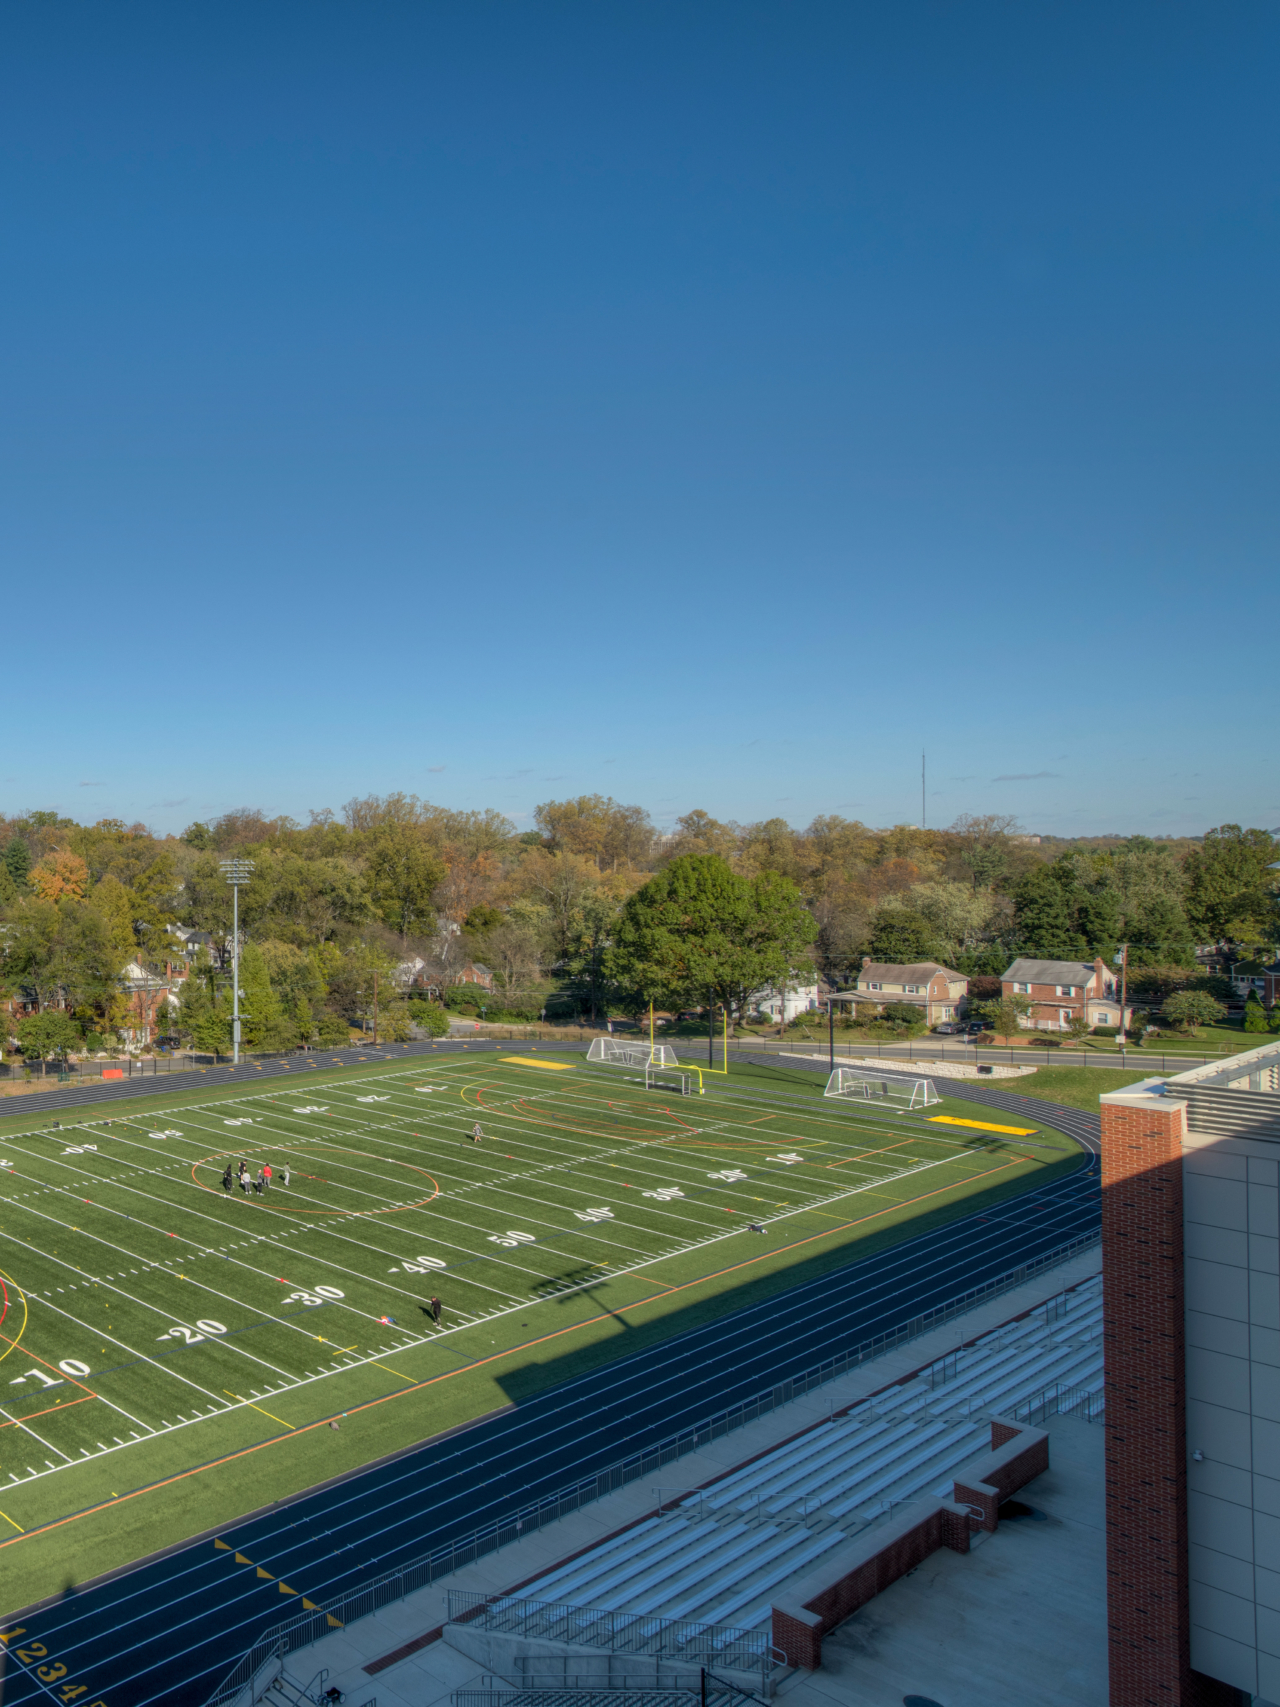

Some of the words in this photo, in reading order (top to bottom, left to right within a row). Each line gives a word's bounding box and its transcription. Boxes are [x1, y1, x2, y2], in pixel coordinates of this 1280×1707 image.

[148, 1129, 184, 1139] 50
[65, 1144, 98, 1154] 40
[765, 1153, 804, 1165] 10
[707, 1169, 748, 1183] 20
[642, 1188, 685, 1201] 30
[573, 1208, 615, 1222] 40
[487, 1230, 536, 1247] 50
[401, 1256, 447, 1274] 40
[290, 1285, 345, 1306] 30
[168, 1319, 228, 1344] 20
[24, 1359, 91, 1388] 10
[15, 1643, 48, 1664] 2
[37, 1662, 68, 1682] 3
[58, 1685, 88, 1703] 4
